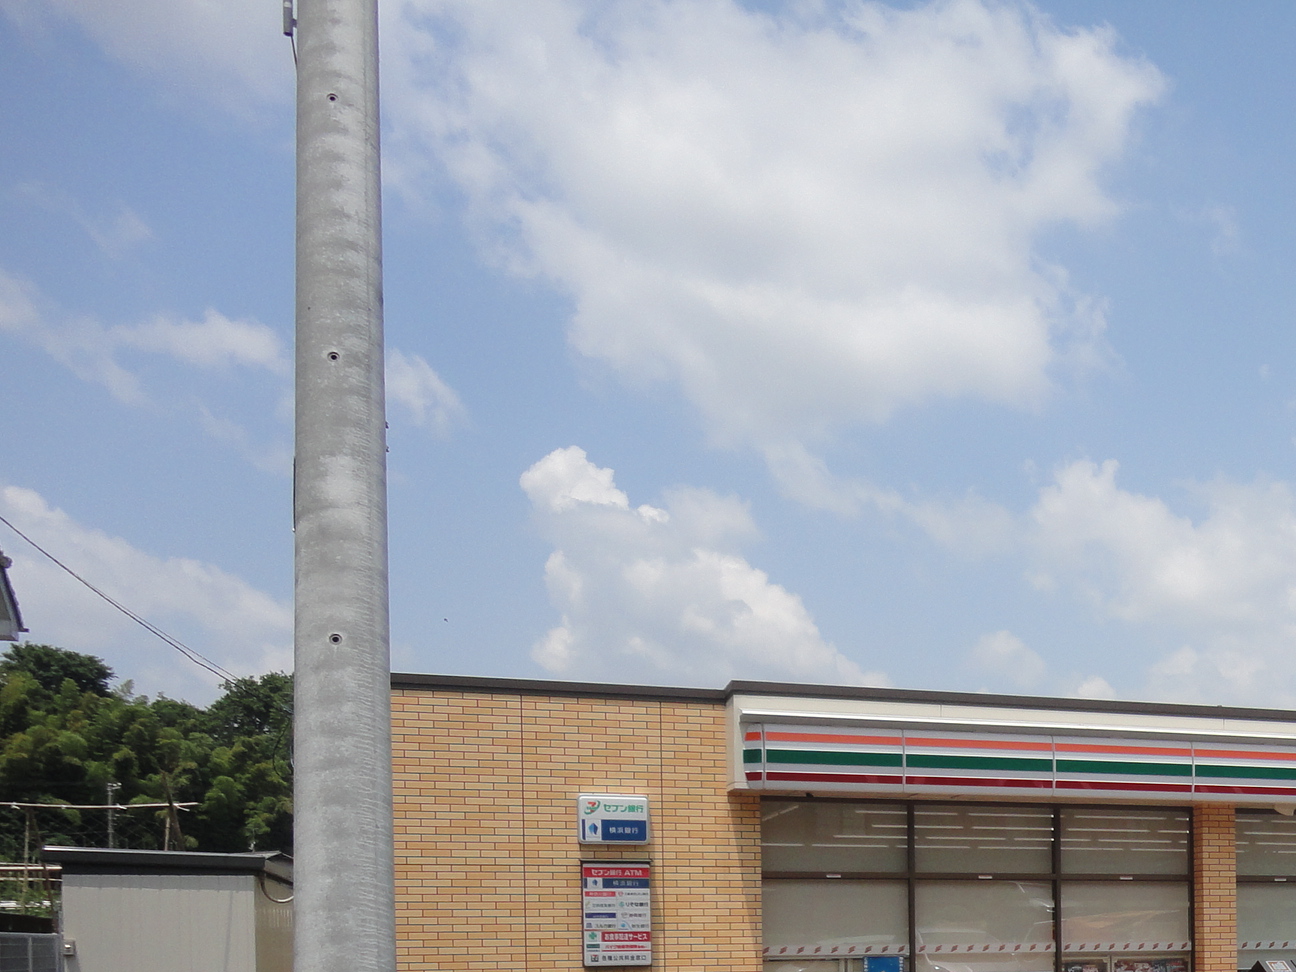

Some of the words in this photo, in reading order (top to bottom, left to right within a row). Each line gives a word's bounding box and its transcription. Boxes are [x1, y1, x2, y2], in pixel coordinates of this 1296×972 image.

[603, 803, 644, 813] セブン銀行
[609, 826, 639, 834] 横浜銀行
